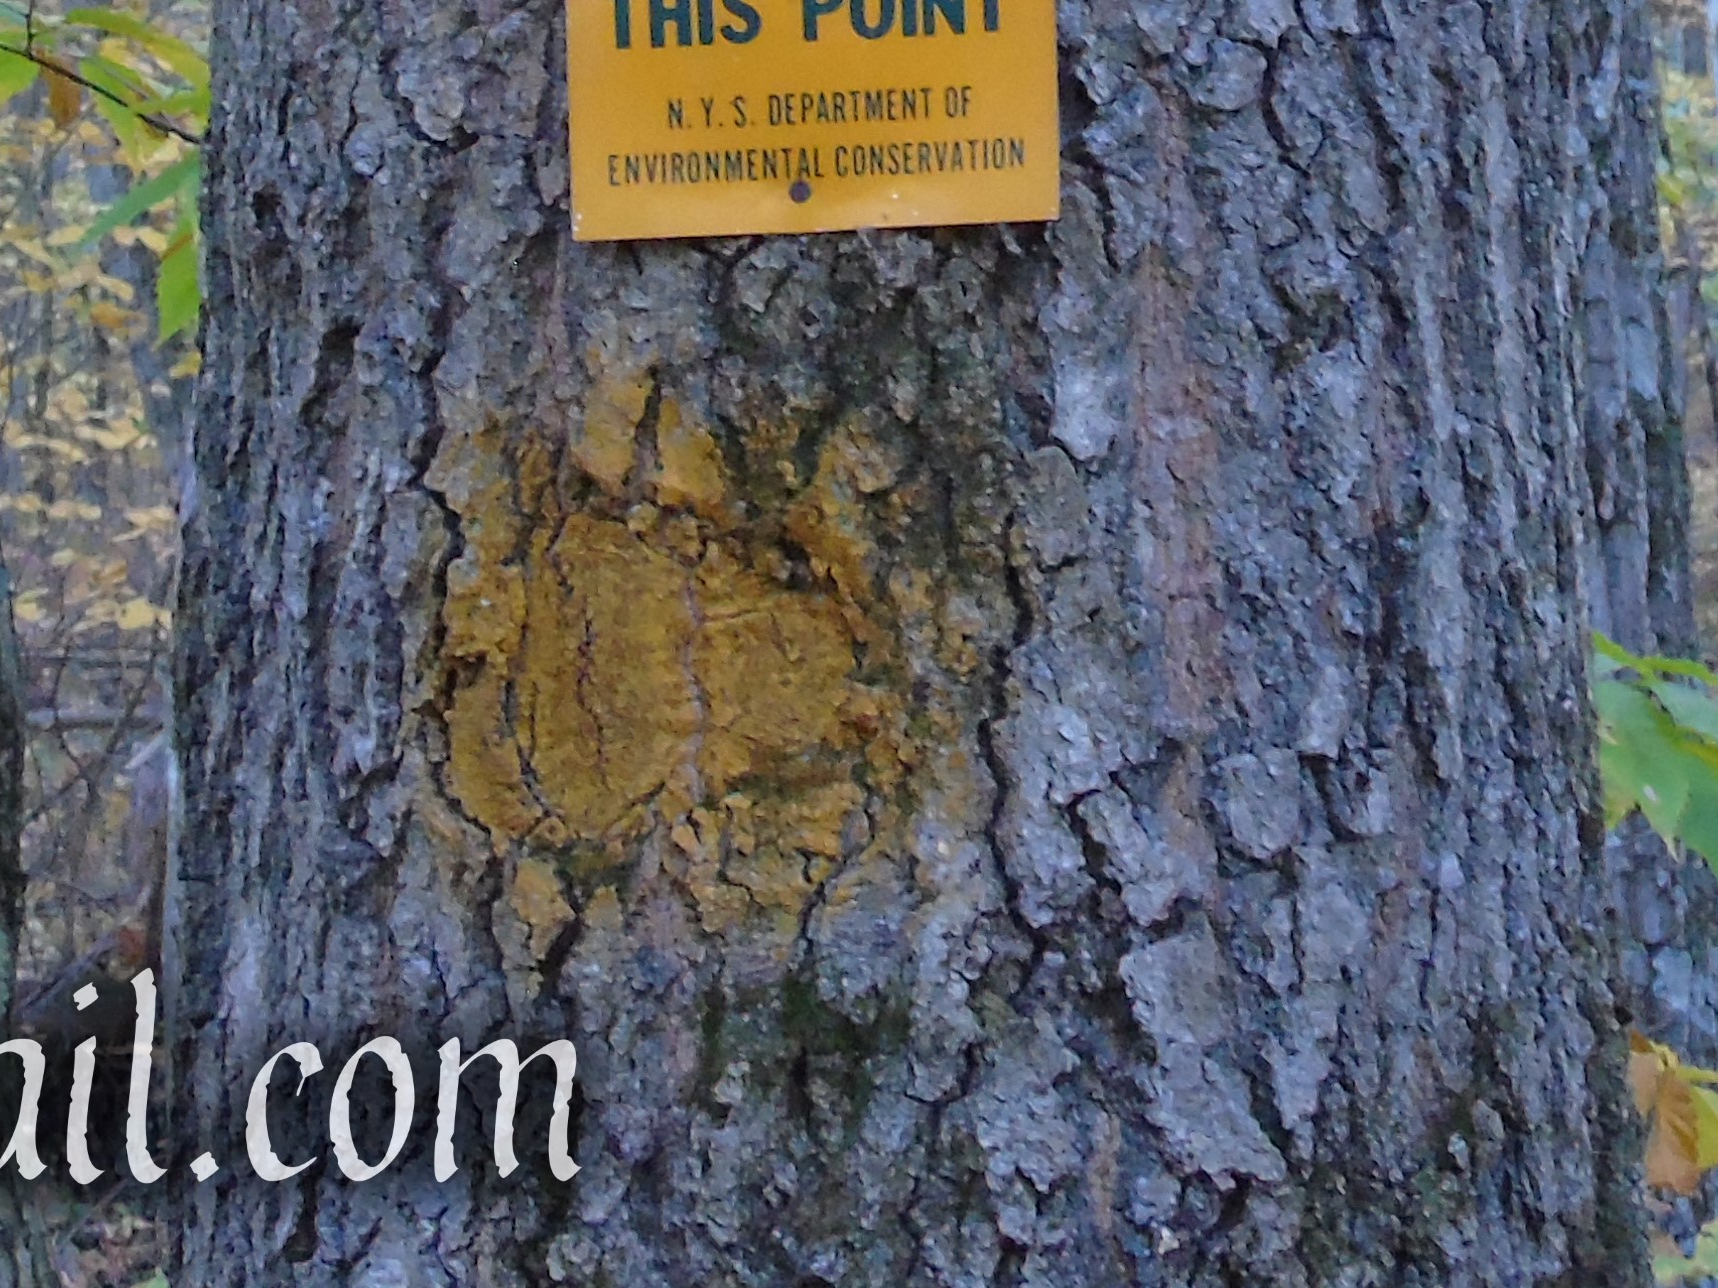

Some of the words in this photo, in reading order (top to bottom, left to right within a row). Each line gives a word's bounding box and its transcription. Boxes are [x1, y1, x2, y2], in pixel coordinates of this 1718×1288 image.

[768, 87, 932, 126] DEPARTMENT
[945, 86, 973, 118] OF
[608, 146, 825, 186] ENVIRONMENTAL
[835, 138, 1026, 178] CONSERVATION
